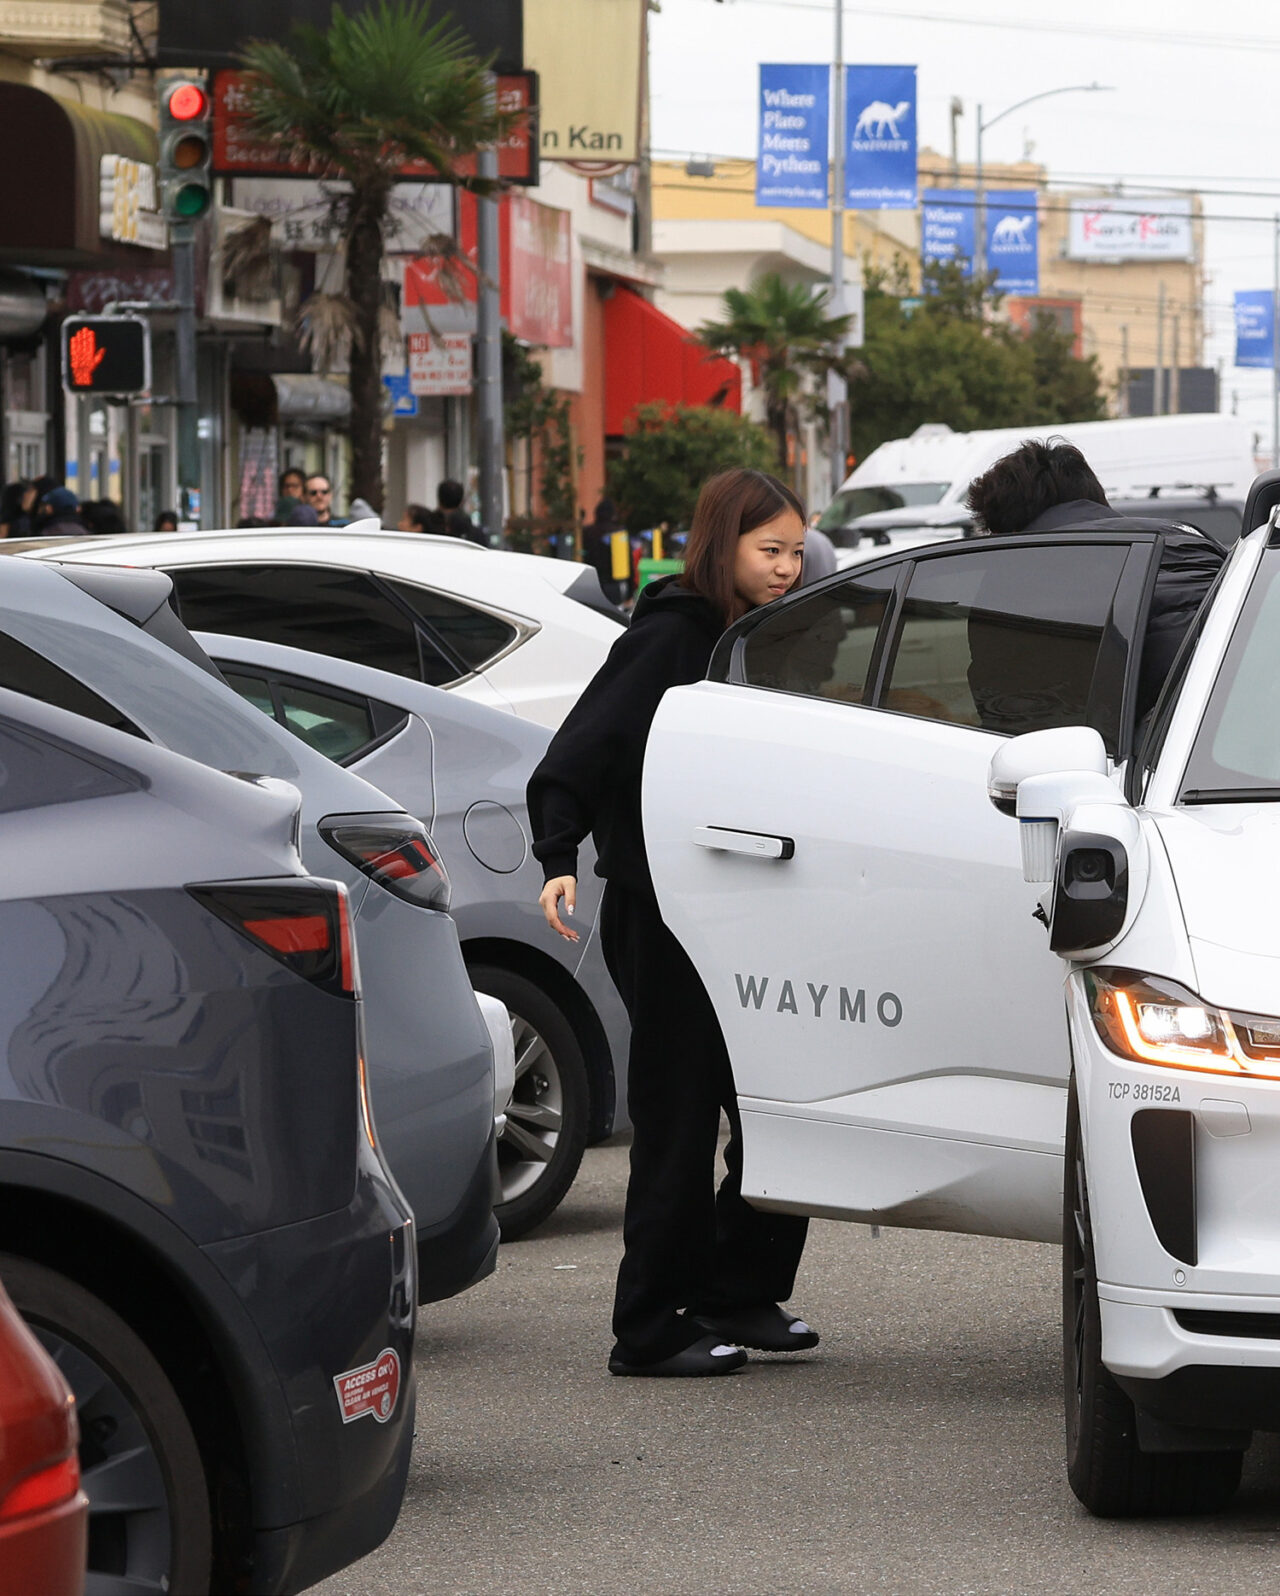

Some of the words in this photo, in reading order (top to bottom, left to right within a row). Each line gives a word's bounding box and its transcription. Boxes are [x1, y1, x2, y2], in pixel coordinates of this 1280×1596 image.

[763, 88, 816, 108] Where
[763, 110, 806, 129] Plato
[569, 125, 623, 150] Kan
[762, 134, 811, 152] Meets
[851, 139, 909, 152] NATIVITY
[762, 154, 821, 177] Python
[735, 973, 903, 1028] WAYMO
[1108, 1082, 1130, 1099] TCP
[1133, 1084, 1181, 1103] 38152A
[344, 1369, 377, 1391] ACCESS
[377, 1363, 390, 1378] OK
